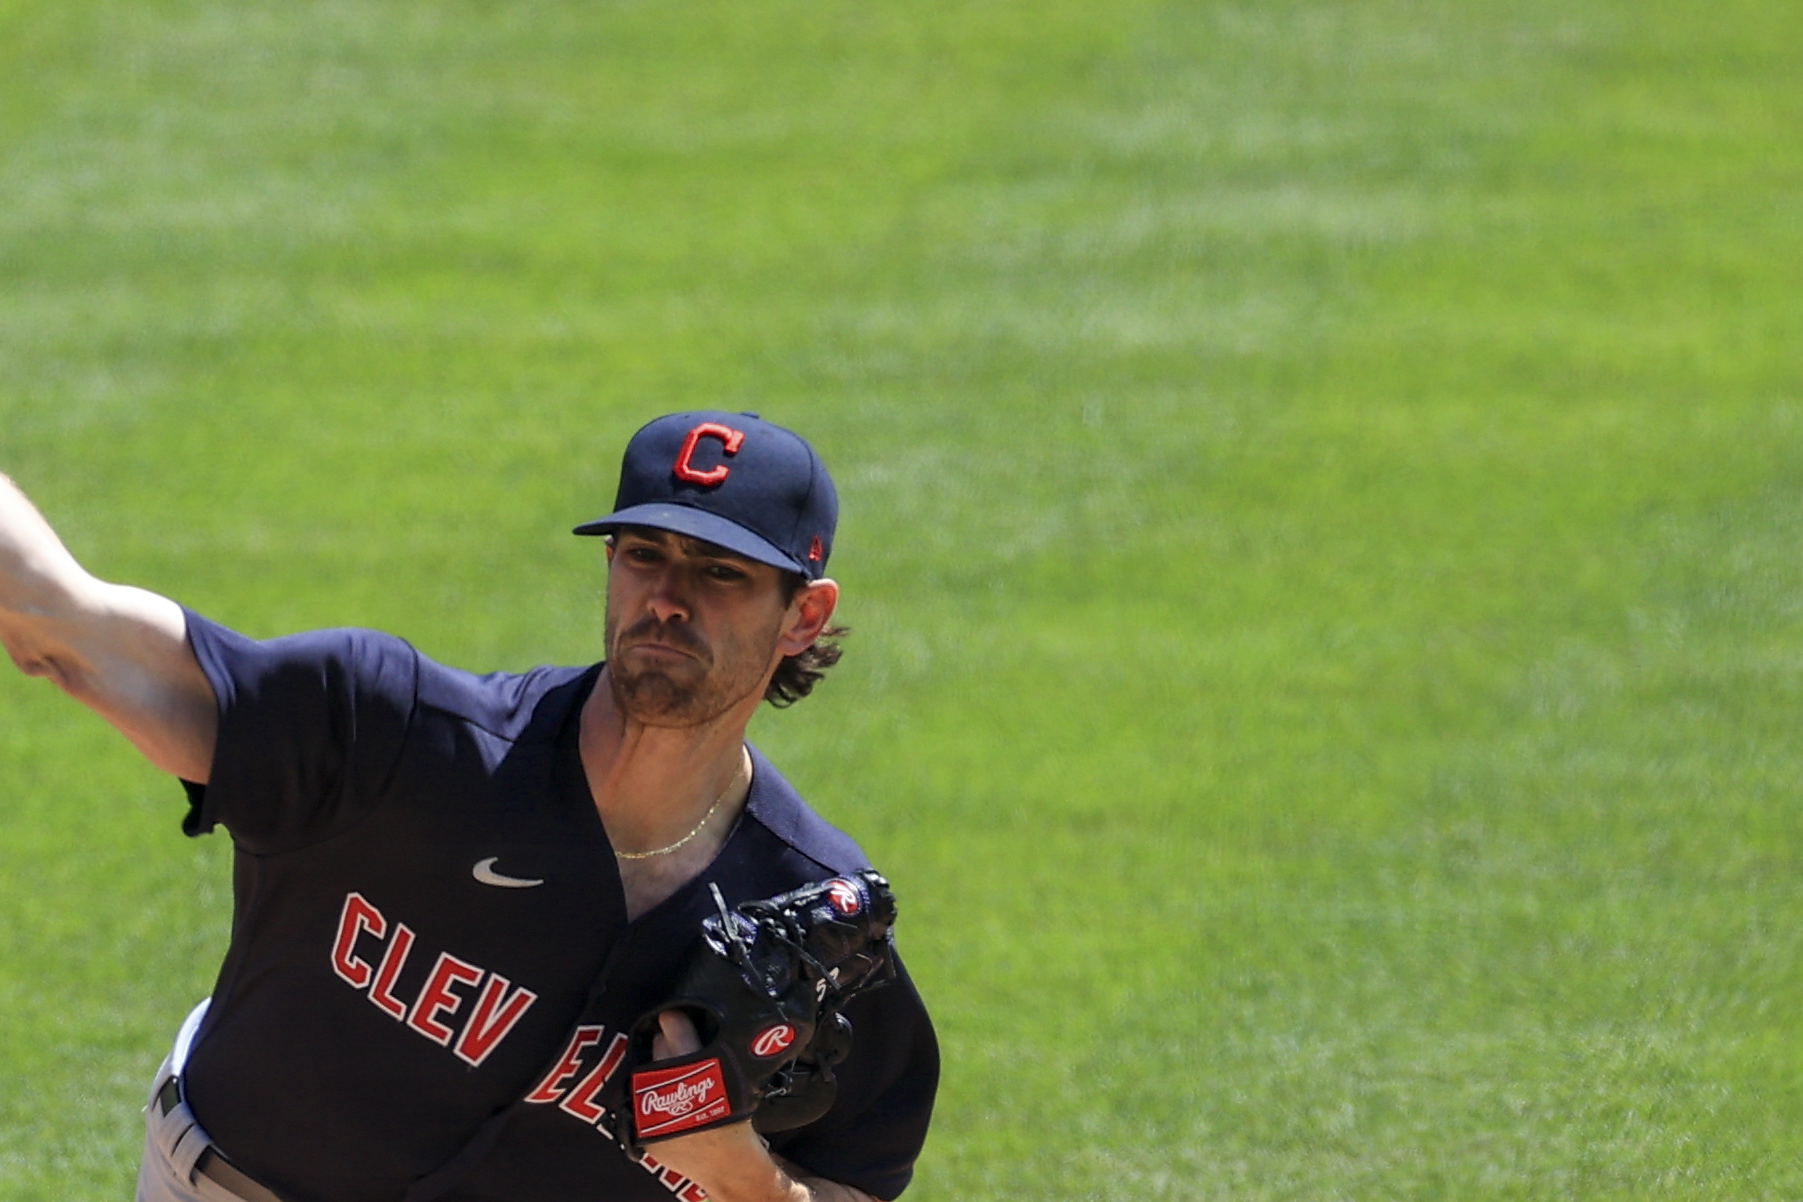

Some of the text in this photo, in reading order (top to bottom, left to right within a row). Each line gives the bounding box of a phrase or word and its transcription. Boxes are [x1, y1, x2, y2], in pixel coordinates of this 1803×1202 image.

[673, 422, 745, 486] C
[754, 1025, 790, 1055] R
[641, 1077, 715, 1116] Rawlings
